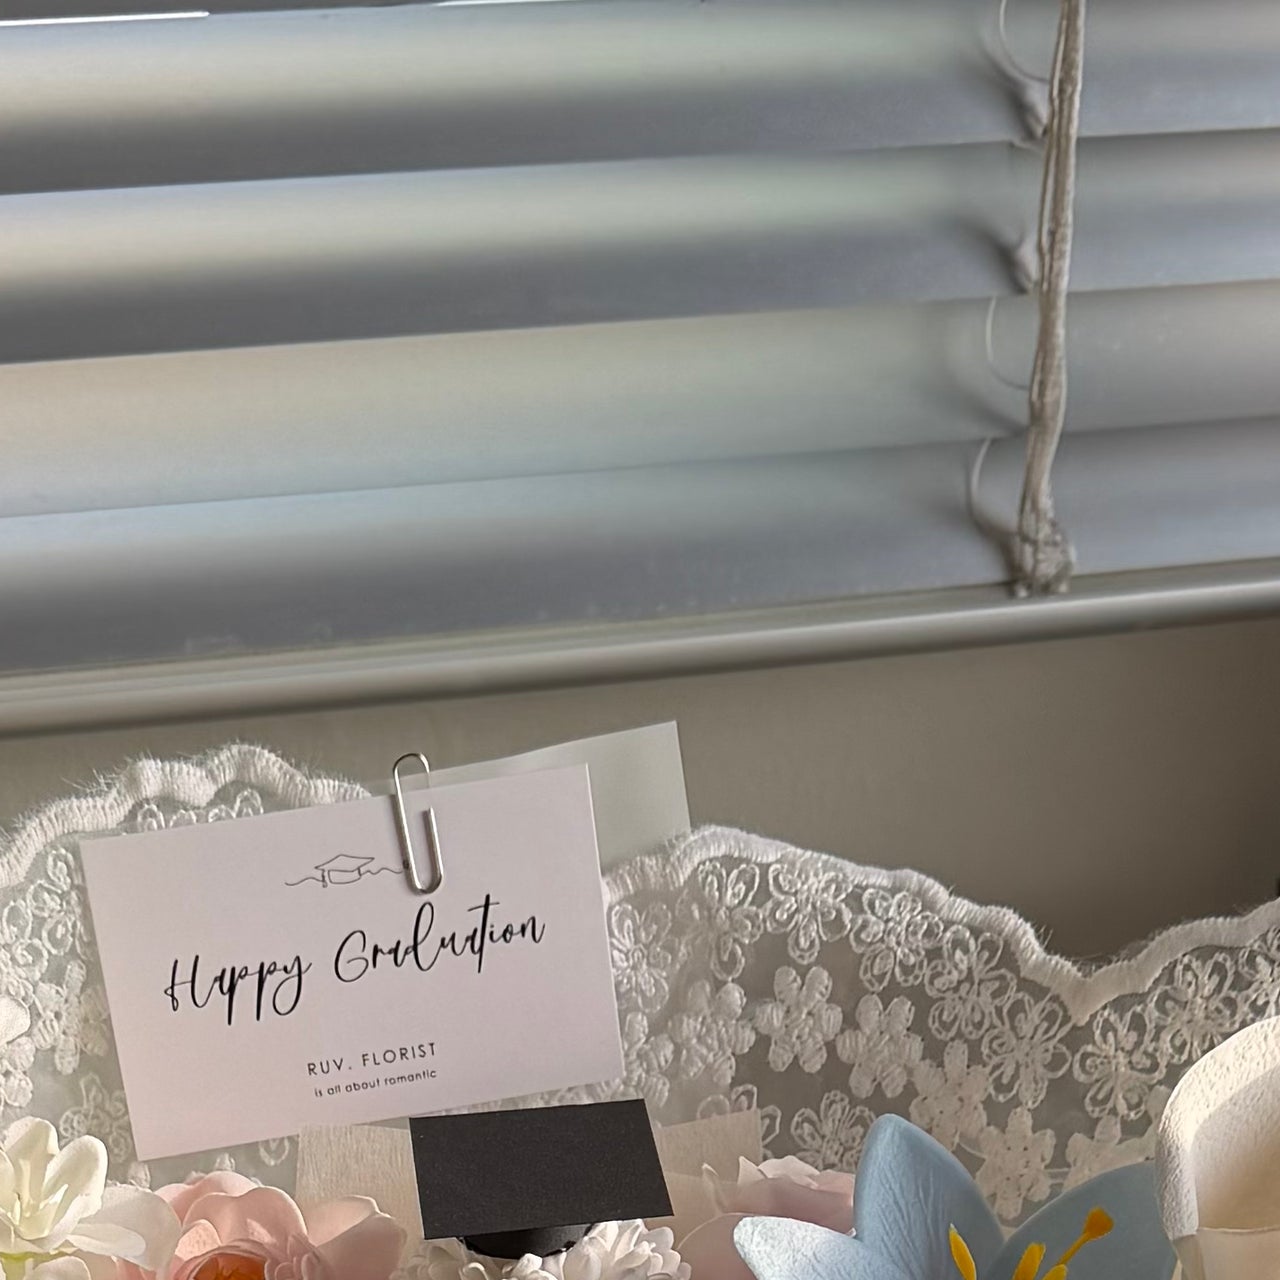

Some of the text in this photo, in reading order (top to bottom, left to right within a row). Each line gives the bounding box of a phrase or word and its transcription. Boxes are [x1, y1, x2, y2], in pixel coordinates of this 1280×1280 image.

[164, 894, 546, 1026] Happy Graduation
[361, 1042, 436, 1067] FLORIST
[327, 1085, 341, 1096] all
[345, 1078, 380, 1093] about
[384, 1069, 437, 1086] romantic
